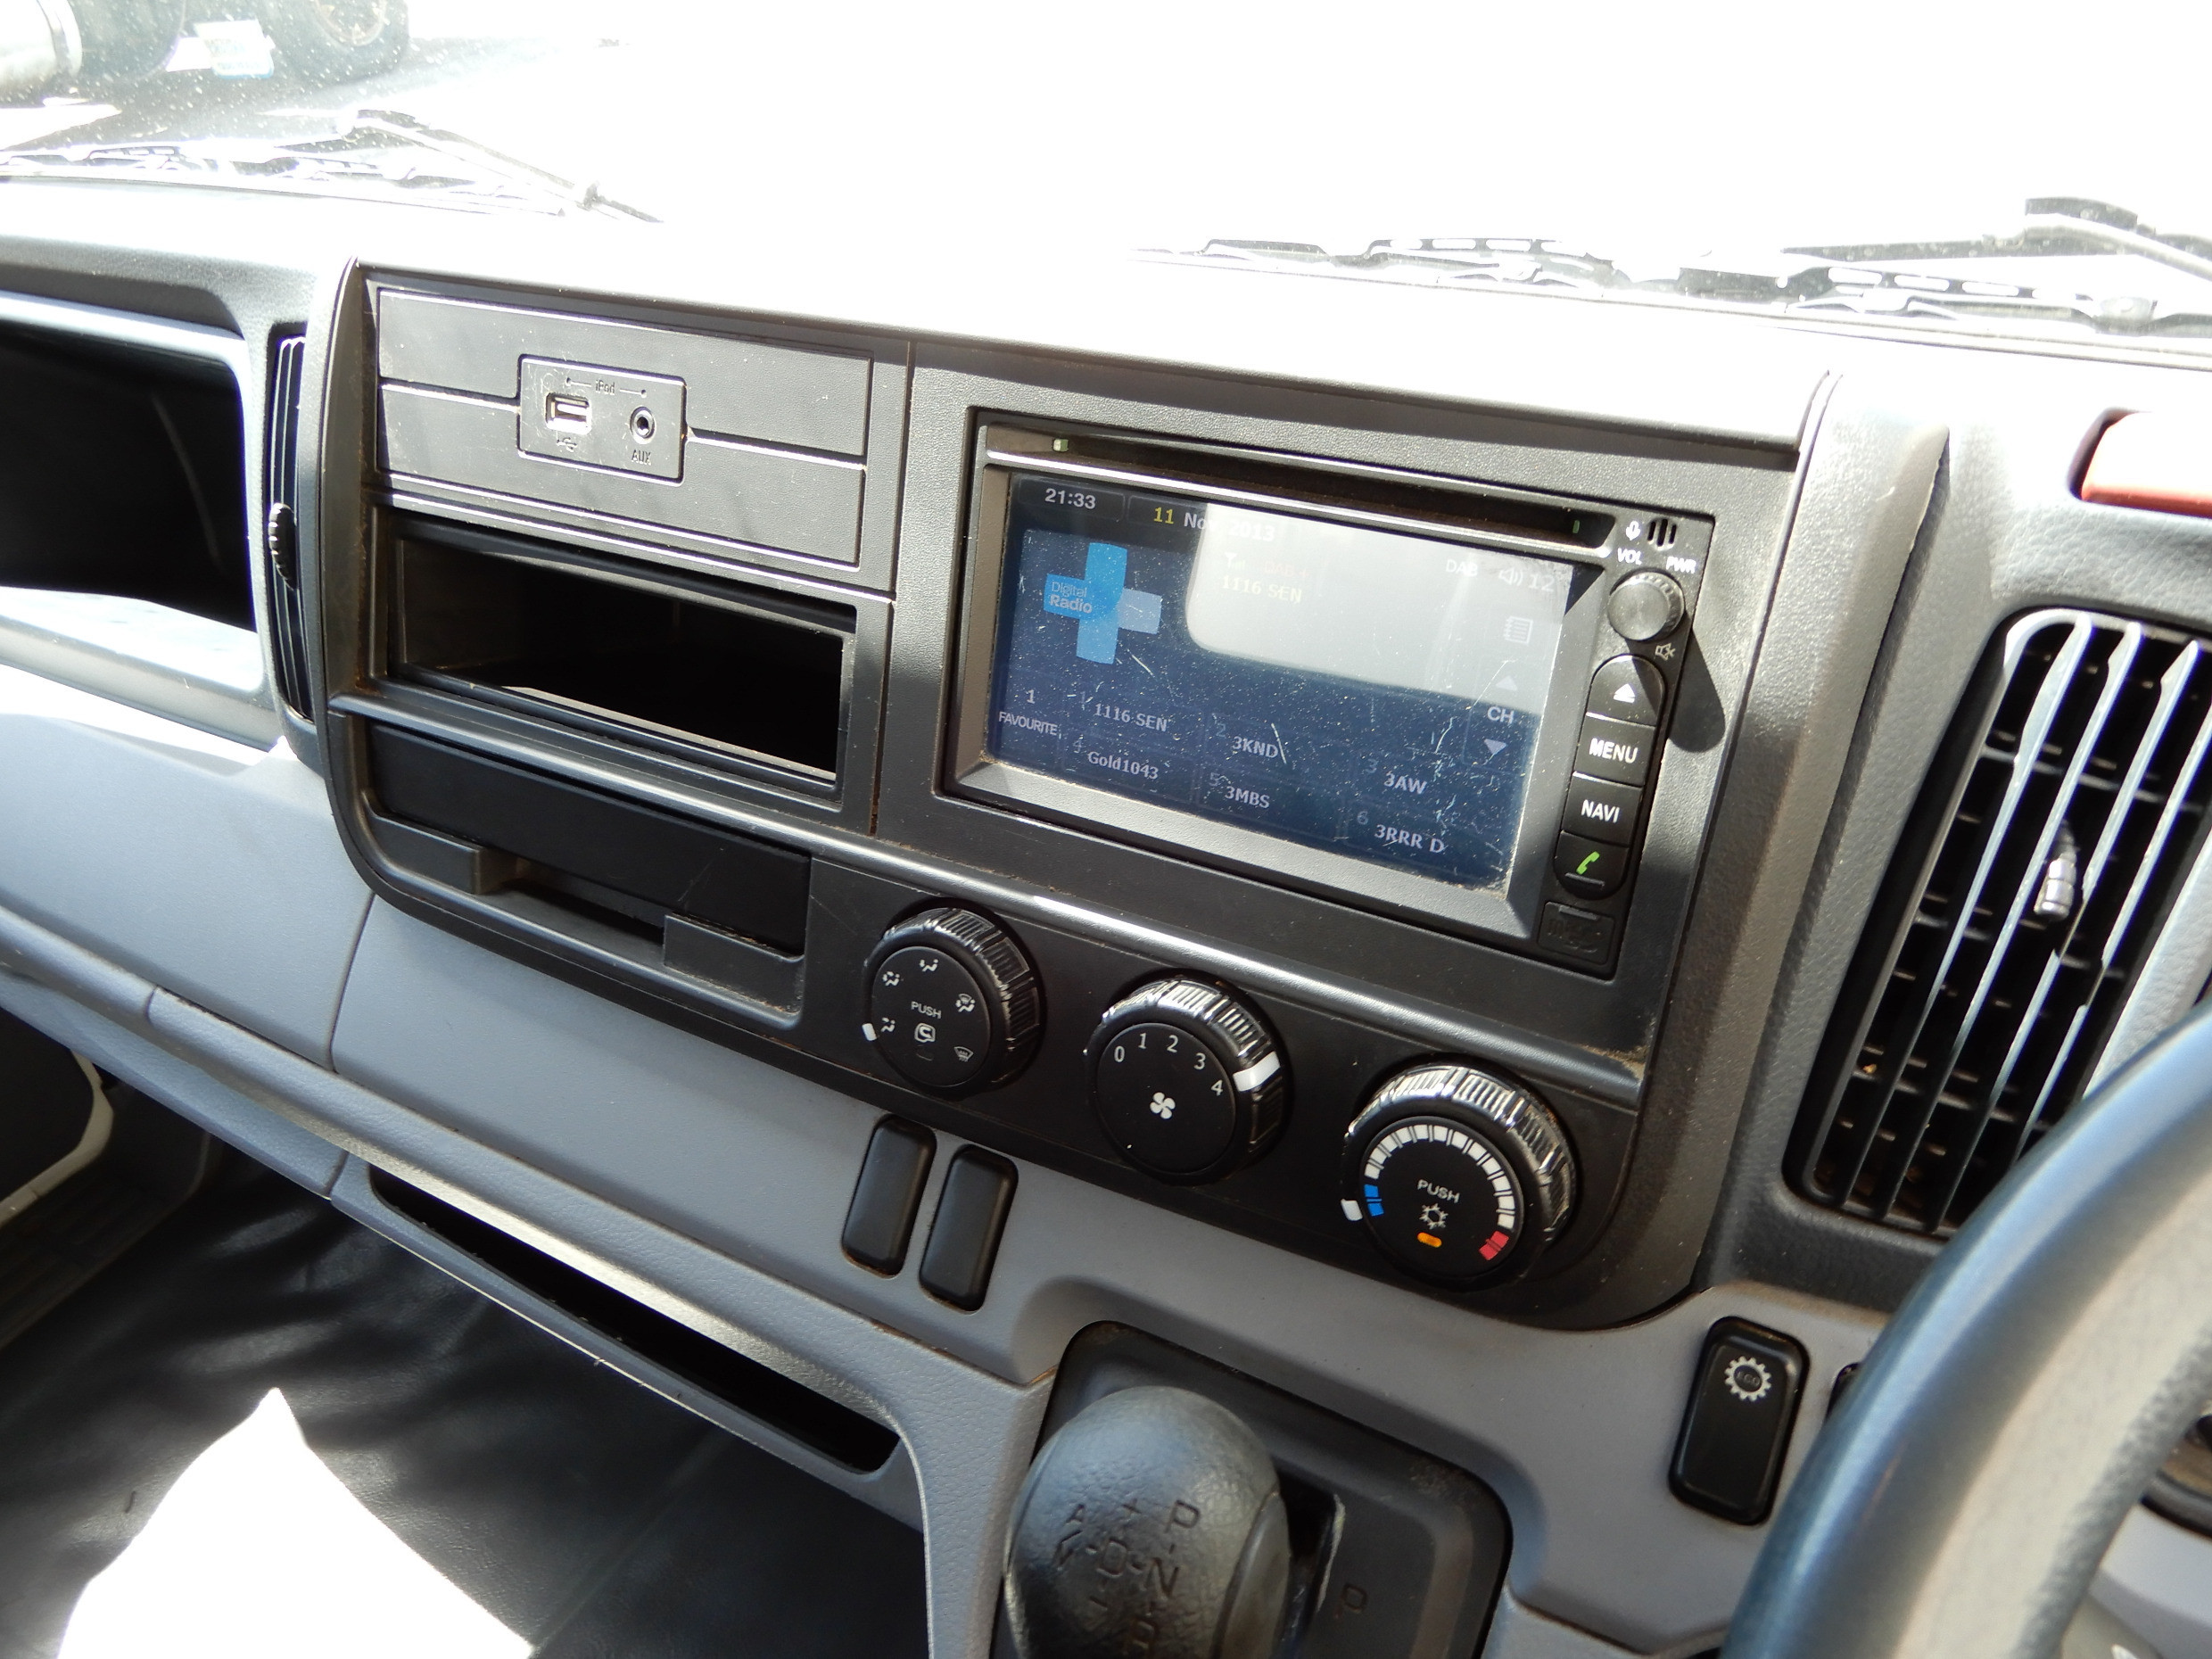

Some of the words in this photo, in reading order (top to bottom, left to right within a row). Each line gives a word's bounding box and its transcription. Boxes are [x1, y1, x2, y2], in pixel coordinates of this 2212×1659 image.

[595, 380, 615, 395] iPod
[631, 449, 652, 466] AUX
[1044, 488, 1096, 510] 21:33
[1152, 507, 1175, 524] 11
[1445, 558, 1479, 578] DAB
[1617, 548, 1643, 565] VOL
[1665, 556, 1696, 574] PWR
[1051, 581, 1088, 598] Digital
[1221, 574, 1263, 596] 1116
[1268, 583, 1302, 604] SEN
[1529, 573, 1556, 593] 12
[1049, 594, 1094, 614] Radio
[998, 711, 1059, 737] FAVOURITE
[1094, 702, 1130, 725] 1116
[1135, 713, 1168, 733] SEN
[1487, 706, 1515, 724] CH
[1232, 735, 1279, 760] 3KND
[1589, 738, 1638, 764] MENU
[1087, 750, 1160, 780] Gold1043
[1383, 771, 1427, 795] 3AW
[1225, 785, 1270, 809] 3MBS
[1581, 799, 1620, 823] NAVI
[1374, 823, 1423, 849] 3RRR
[1430, 838, 1445, 854] D
[911, 1001, 942, 1019] PUSH
[1114, 1045, 1126, 1063] 0
[1137, 1032, 1147, 1050] 1
[1166, 1035, 1179, 1054] 2
[1193, 1052, 1206, 1071] 3
[1210, 1079, 1224, 1097] 4
[1416, 1178, 1461, 1204] PUSH
